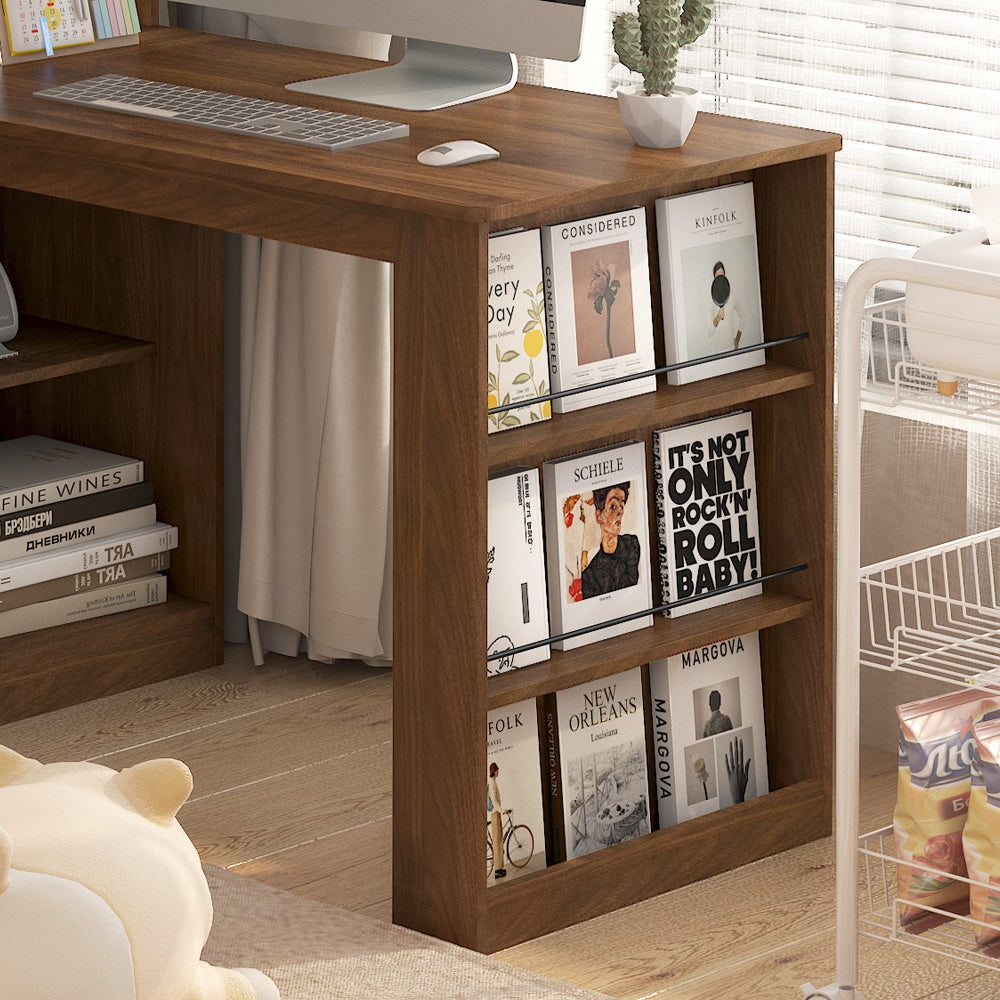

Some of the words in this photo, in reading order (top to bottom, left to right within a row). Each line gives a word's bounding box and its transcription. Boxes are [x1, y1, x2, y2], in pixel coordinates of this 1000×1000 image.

[561, 215, 636, 240] CONSIDERED
[695, 210, 737, 228] KINFOLK
[490, 253, 511, 264] Darling
[497, 264, 515, 273] Thyme
[545, 266, 557, 375] CONSIDERED
[708, 429, 749, 459] NOT
[574, 457, 624, 482] SCHIELE
[668, 451, 750, 505] ONLY
[2, 488, 47, 511] FINE
[56, 471, 122, 498] WINES
[5, 510, 53, 536] БРЭДБЕРИ
[26, 526, 95, 552] ДНЕВНИКИ
[674, 514, 756, 569] ROLL
[676, 550, 758, 600] BABY!
[681, 637, 745, 669] MARGOVA
[583, 684, 617, 711] NEW
[569, 697, 637, 732] ORLEANS
[545, 712, 557, 767] ORLEANS
[590, 728, 618, 743] Louisiana
[654, 698, 672, 799] MARGOVA
[550, 771, 558, 797] NEW
